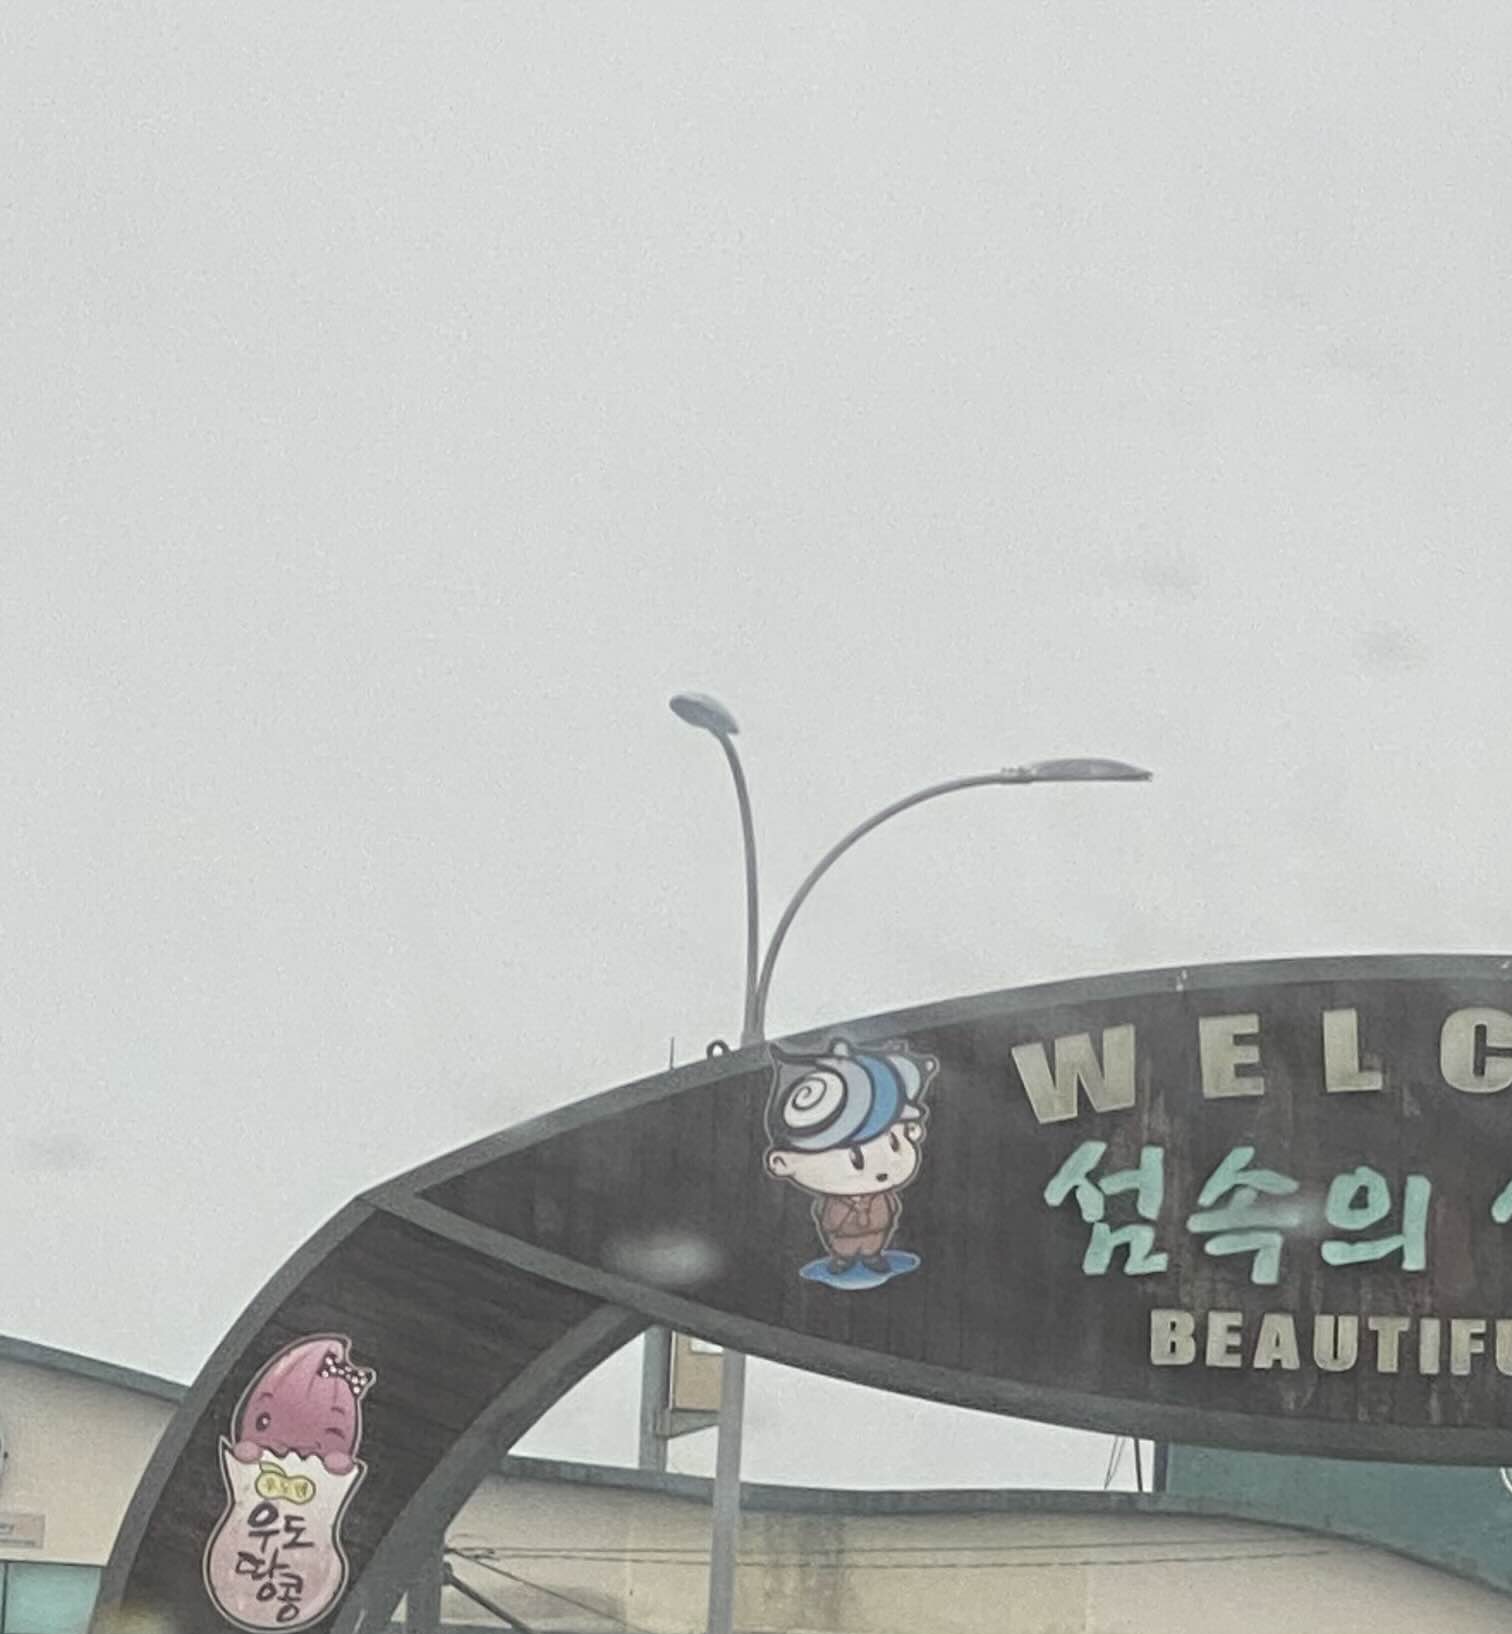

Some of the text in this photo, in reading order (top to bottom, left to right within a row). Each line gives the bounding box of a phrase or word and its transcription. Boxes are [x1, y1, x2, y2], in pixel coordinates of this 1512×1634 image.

[1043, 1140, 1429, 1286] 섬속의
[248, 1501, 314, 1552] 우도
[236, 1550, 303, 1622] 땅콩
